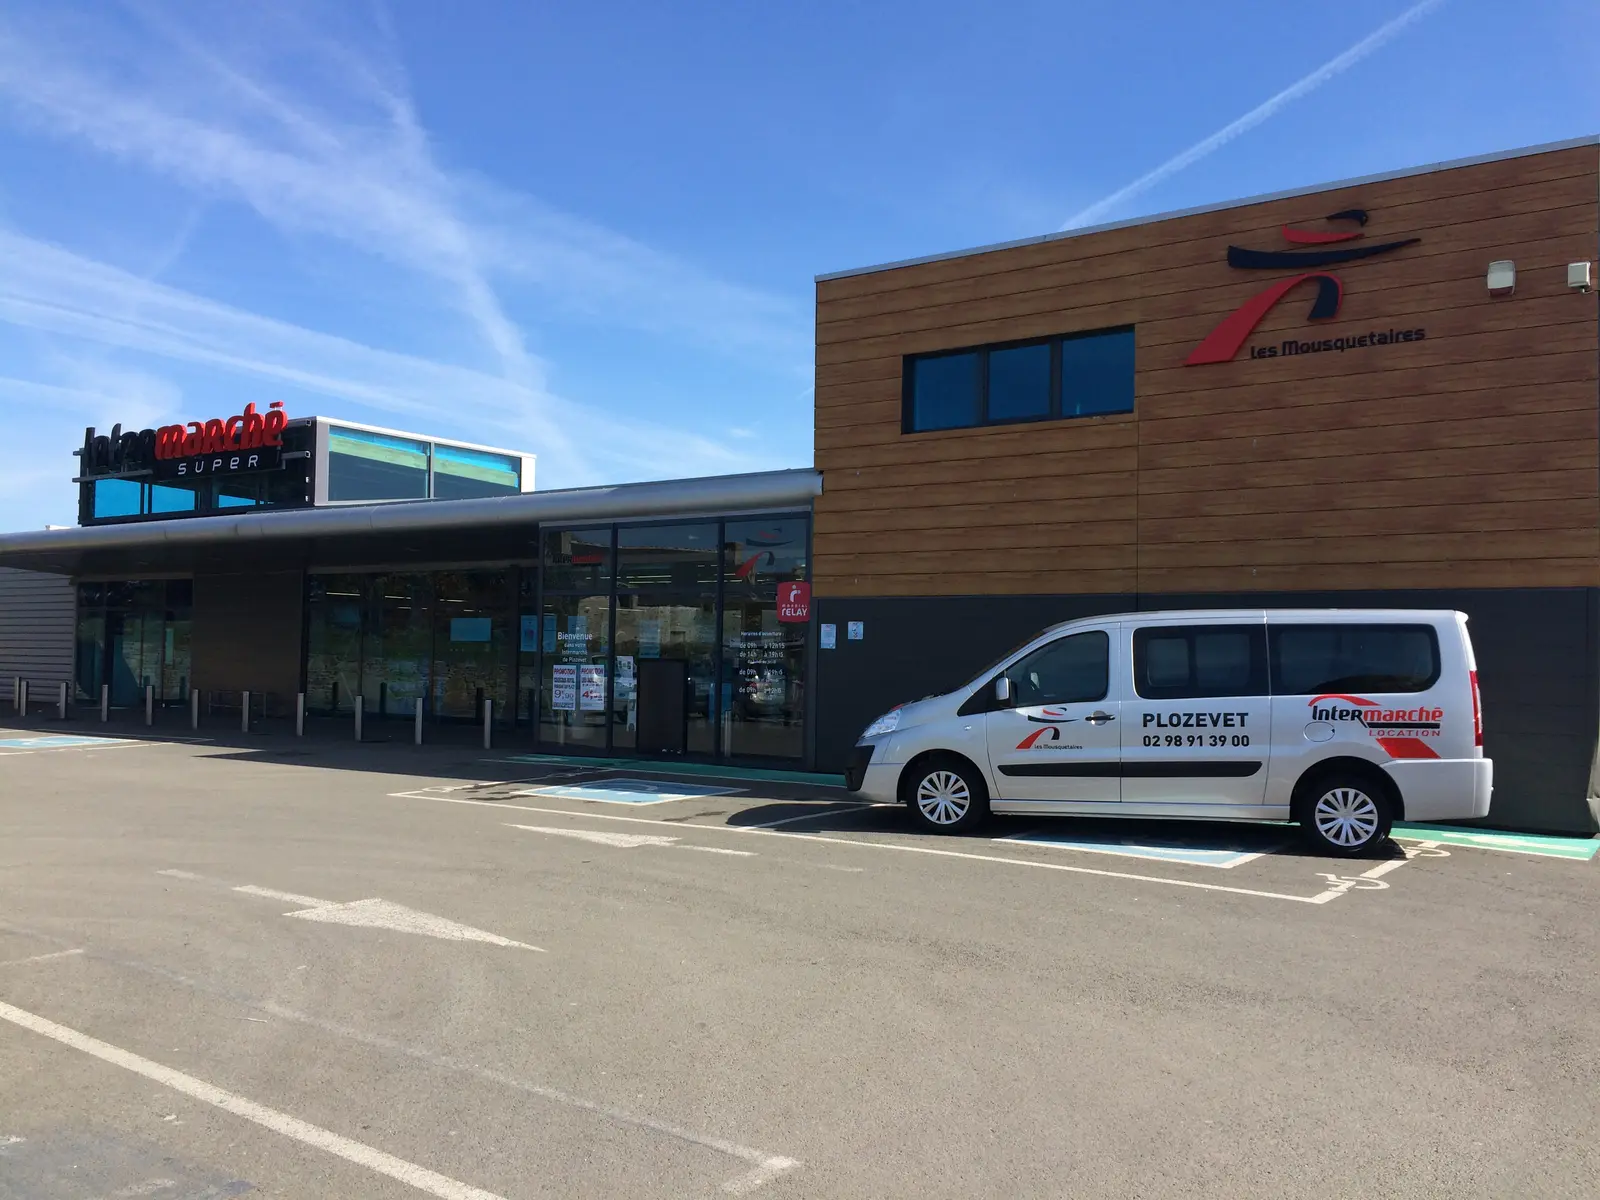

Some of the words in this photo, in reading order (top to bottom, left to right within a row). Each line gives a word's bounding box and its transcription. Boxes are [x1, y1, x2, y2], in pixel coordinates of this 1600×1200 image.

[1282, 327, 1426, 356] Mousquetaires
[177, 454, 260, 476] SUPER
[557, 631, 593, 641] Bienvenue
[1142, 712, 1249, 728] PLOZEVET
[1311, 705, 1444, 728] Intermarché
[1142, 735, 1161, 747] 02
[1165, 735, 1182, 747] 98
[1186, 735, 1203, 747] 91
[1209, 735, 1226, 747] 39
[1231, 735, 1250, 747] 00
[1368, 729, 1441, 737] LOCATION
